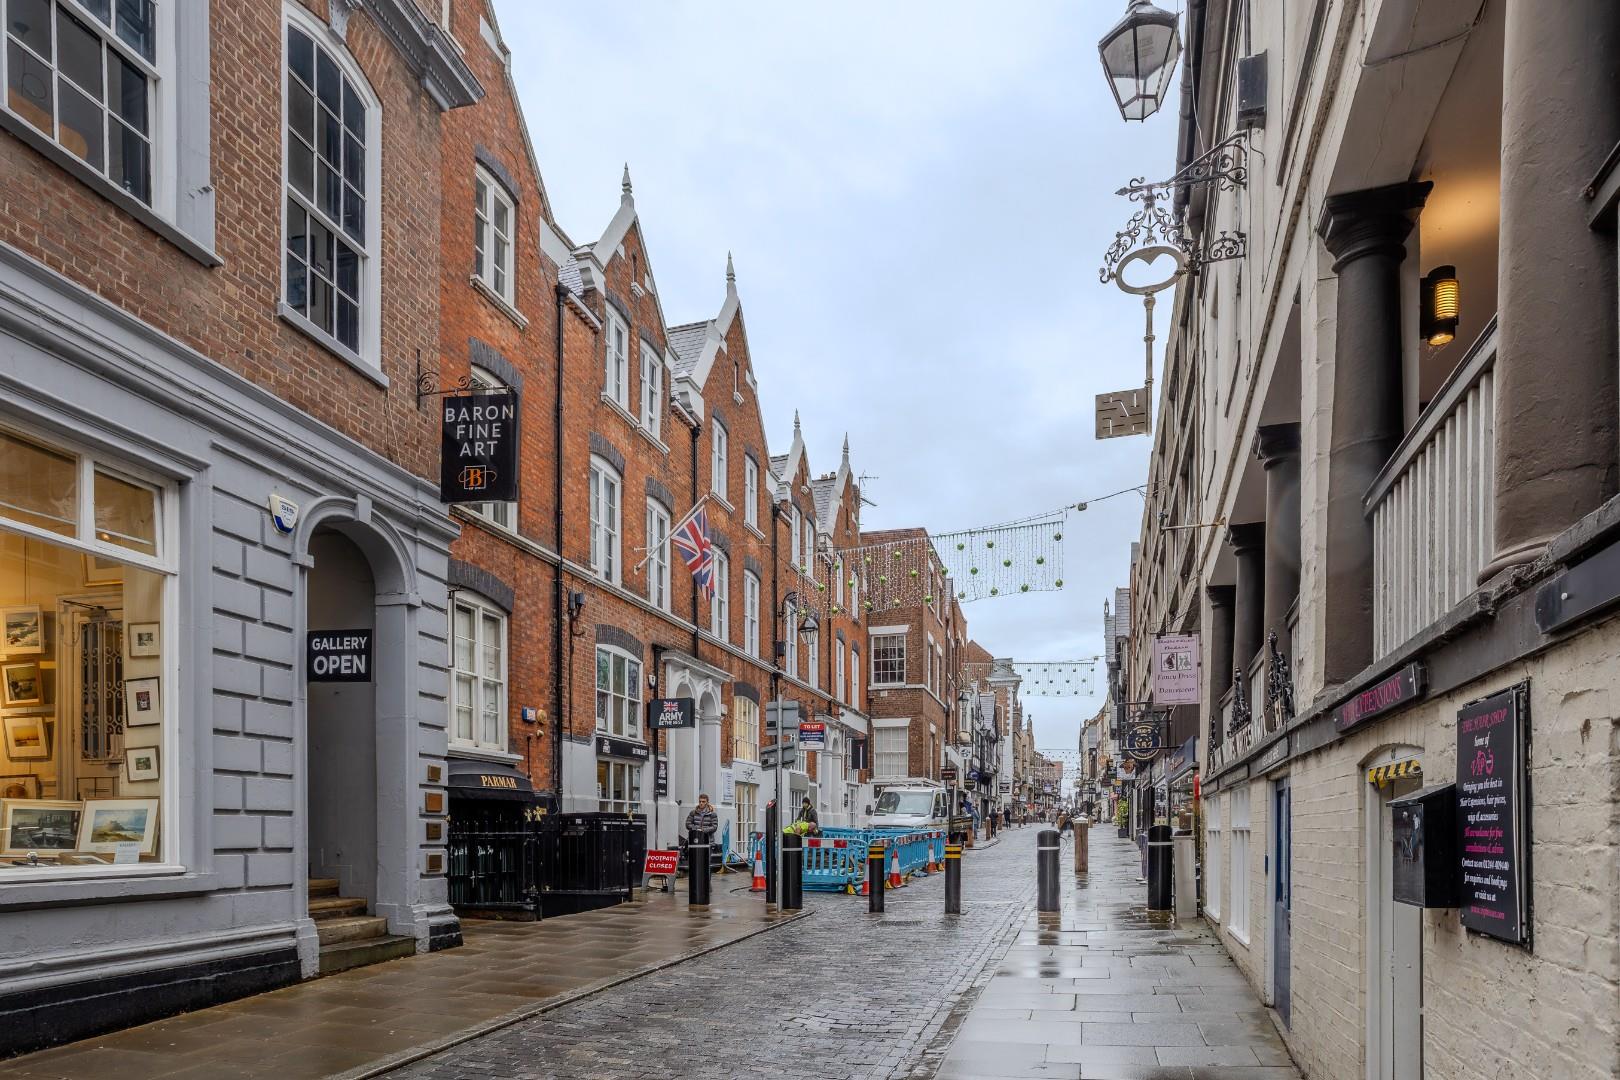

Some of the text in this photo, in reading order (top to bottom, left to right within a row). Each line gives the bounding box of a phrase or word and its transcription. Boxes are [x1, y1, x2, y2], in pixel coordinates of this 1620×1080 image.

[445, 405, 514, 422] BARON
[456, 423, 501, 440] FINE
[459, 441, 498, 457] ART
[312, 636, 368, 650] GALLERY
[313, 654, 366, 675] OPEN
[1157, 672, 1197, 681] Fancy Dress
[659, 711, 684, 721] ARMY
[1489, 708, 1508, 726] SHOP
[1484, 731, 1491, 748] of
[481, 775, 518, 789] PARMAR
[1497, 777, 1503, 788] in
